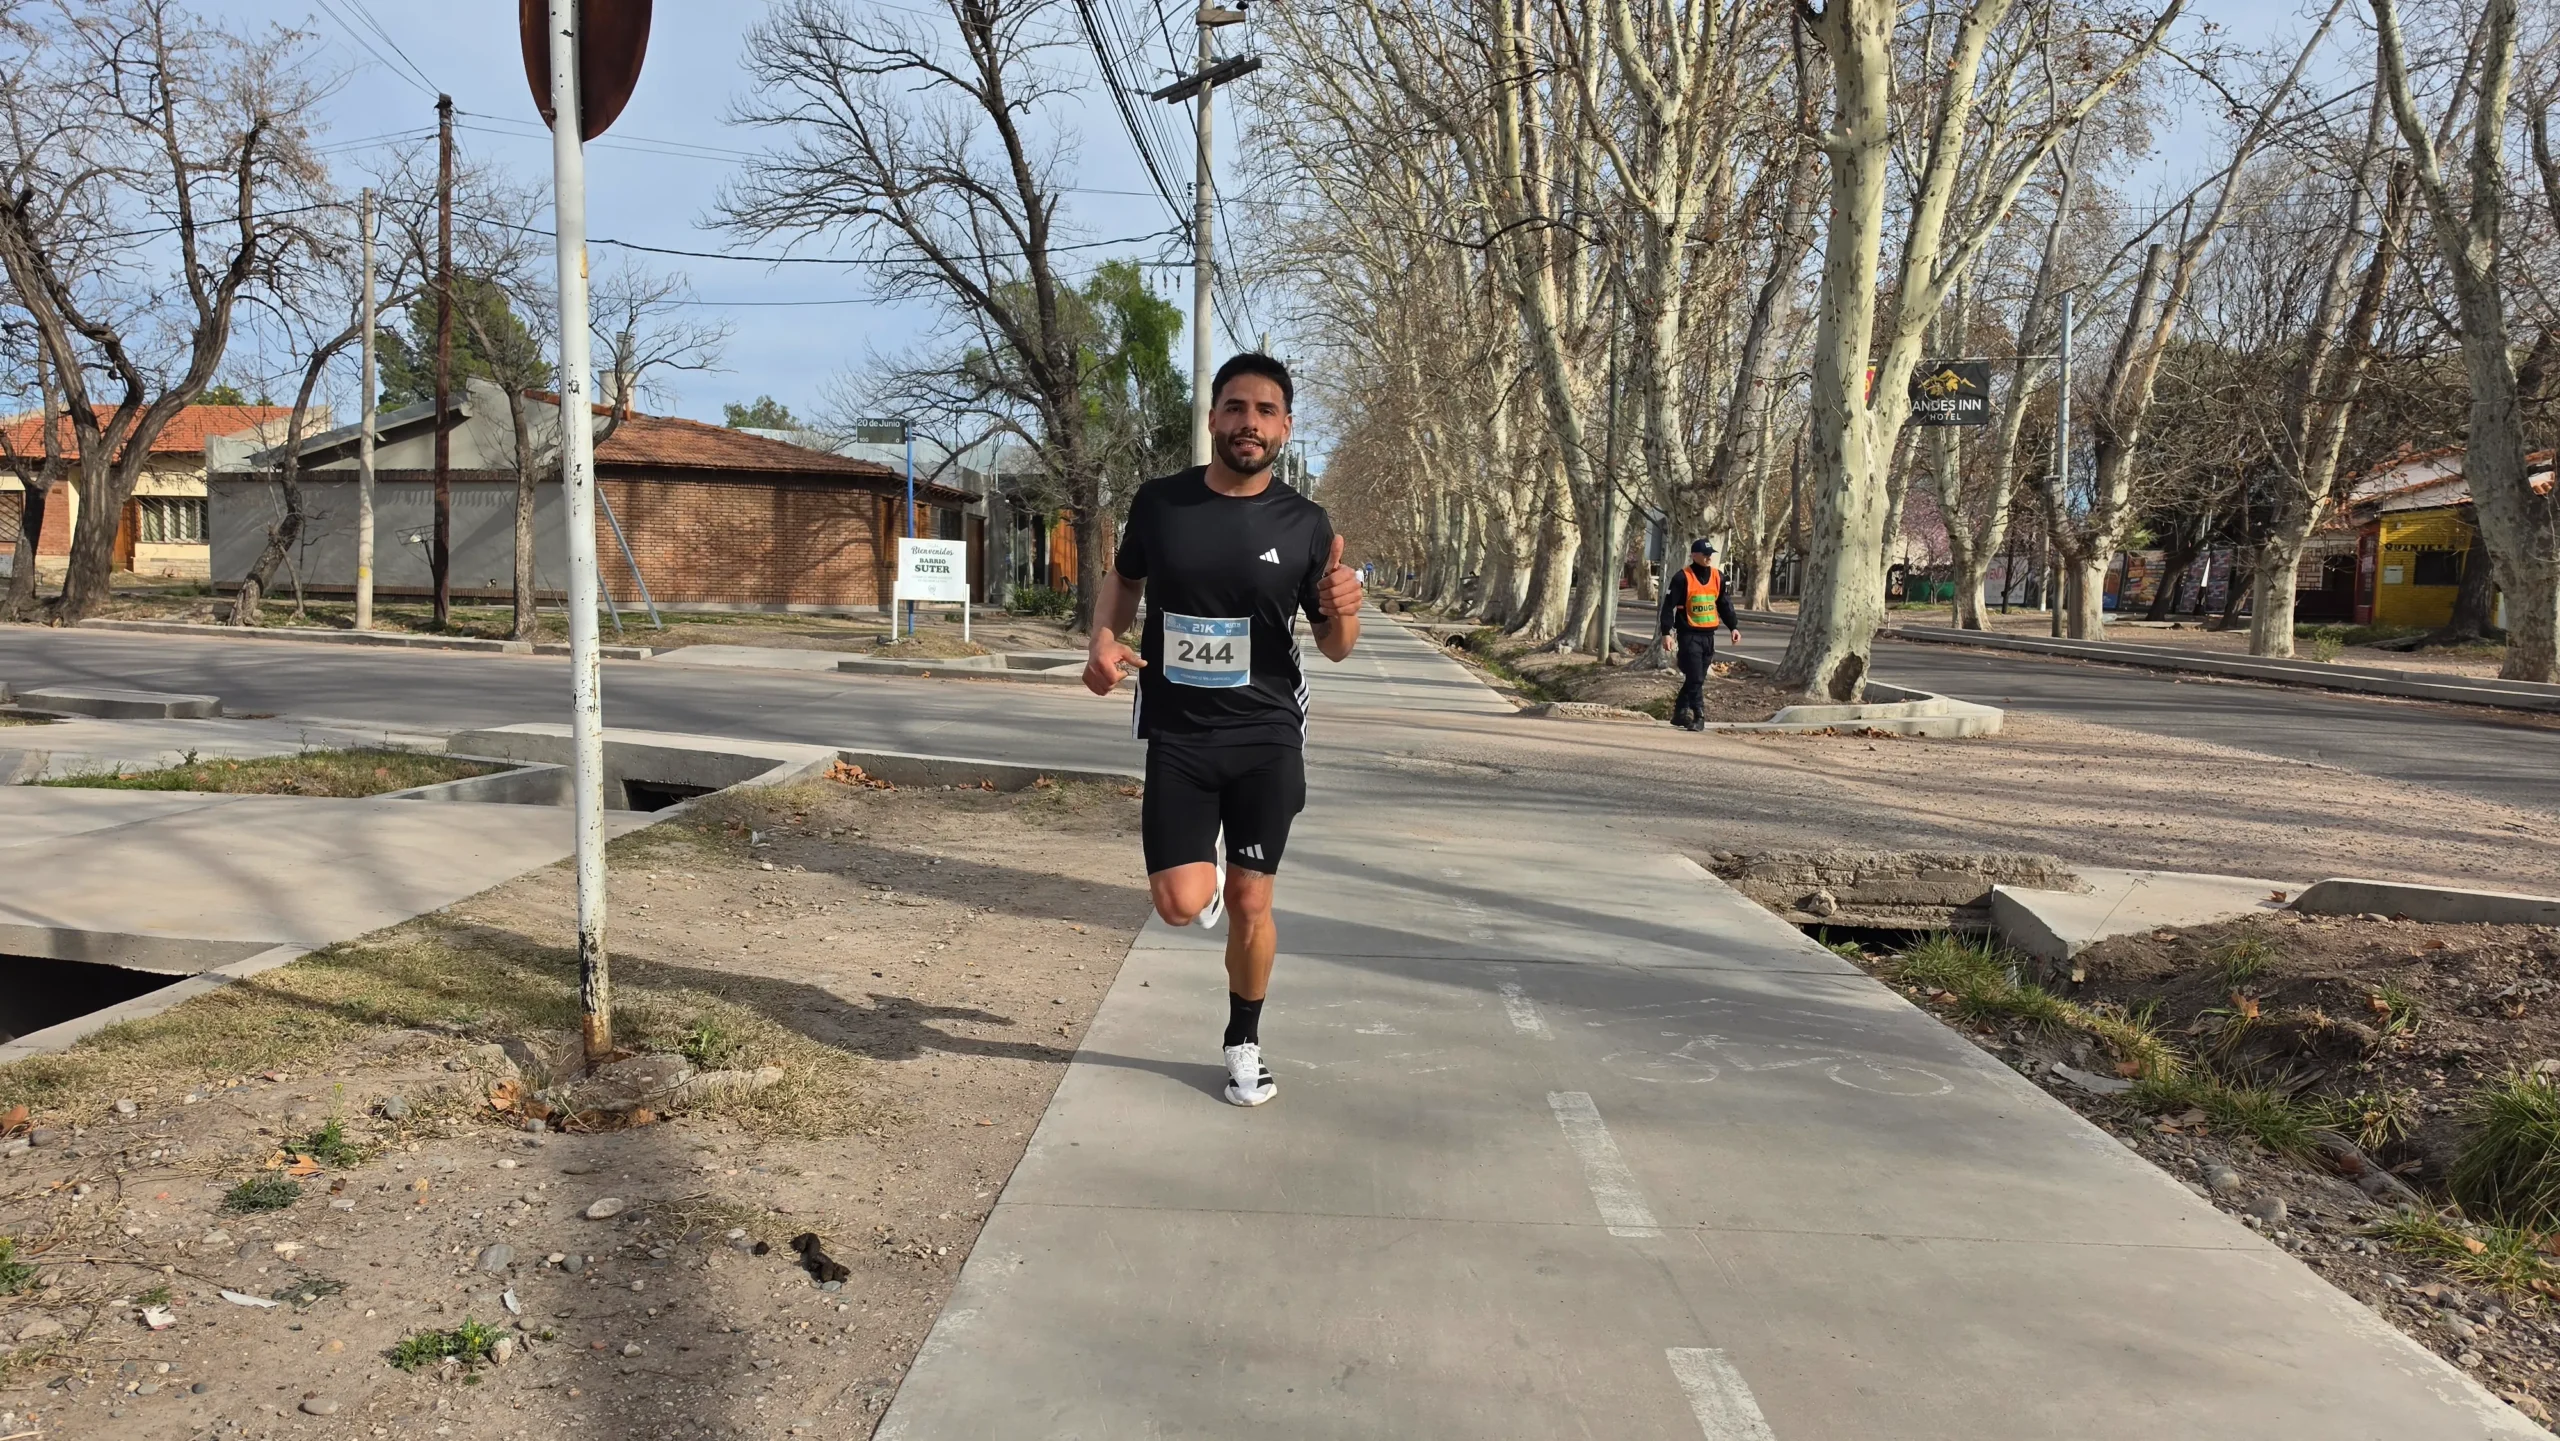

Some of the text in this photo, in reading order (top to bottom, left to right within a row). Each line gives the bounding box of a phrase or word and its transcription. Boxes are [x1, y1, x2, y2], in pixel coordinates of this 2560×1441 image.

[1912, 399, 1982, 412] ANDES INN
[1930, 413, 1961, 421] HOTEL
[857, 419, 900, 427] 20 de Junio
[911, 546, 954, 556] Bienvenidos
[914, 565, 950, 573] SUTER
[1192, 623, 1215, 634] 21K
[1178, 640, 1234, 664] 244
